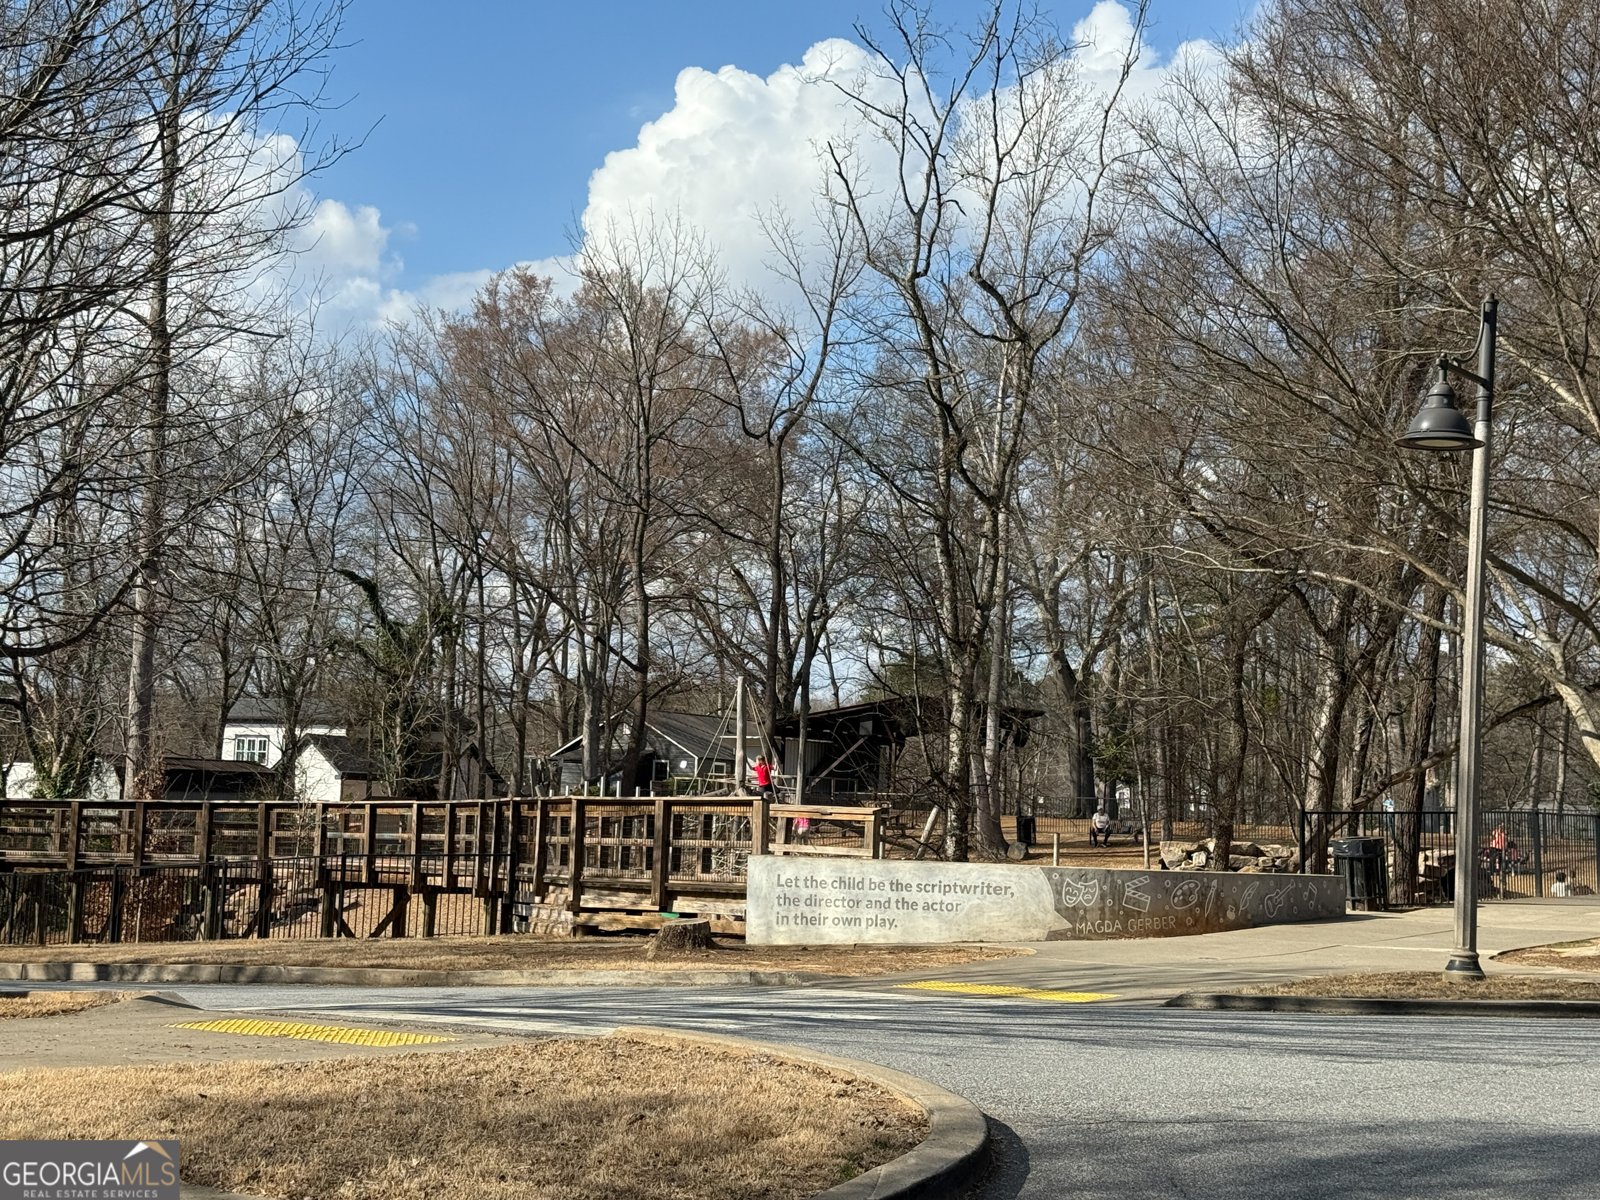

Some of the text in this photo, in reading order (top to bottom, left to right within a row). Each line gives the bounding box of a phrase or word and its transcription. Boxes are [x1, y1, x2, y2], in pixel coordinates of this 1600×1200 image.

[776, 874, 1015, 898] Let the child be the scriptwriter,
[776, 893, 962, 913] the director and the actor
[776, 912, 898, 930] in their own play.
[1076, 916, 1176, 935] MAGDA GERBER
